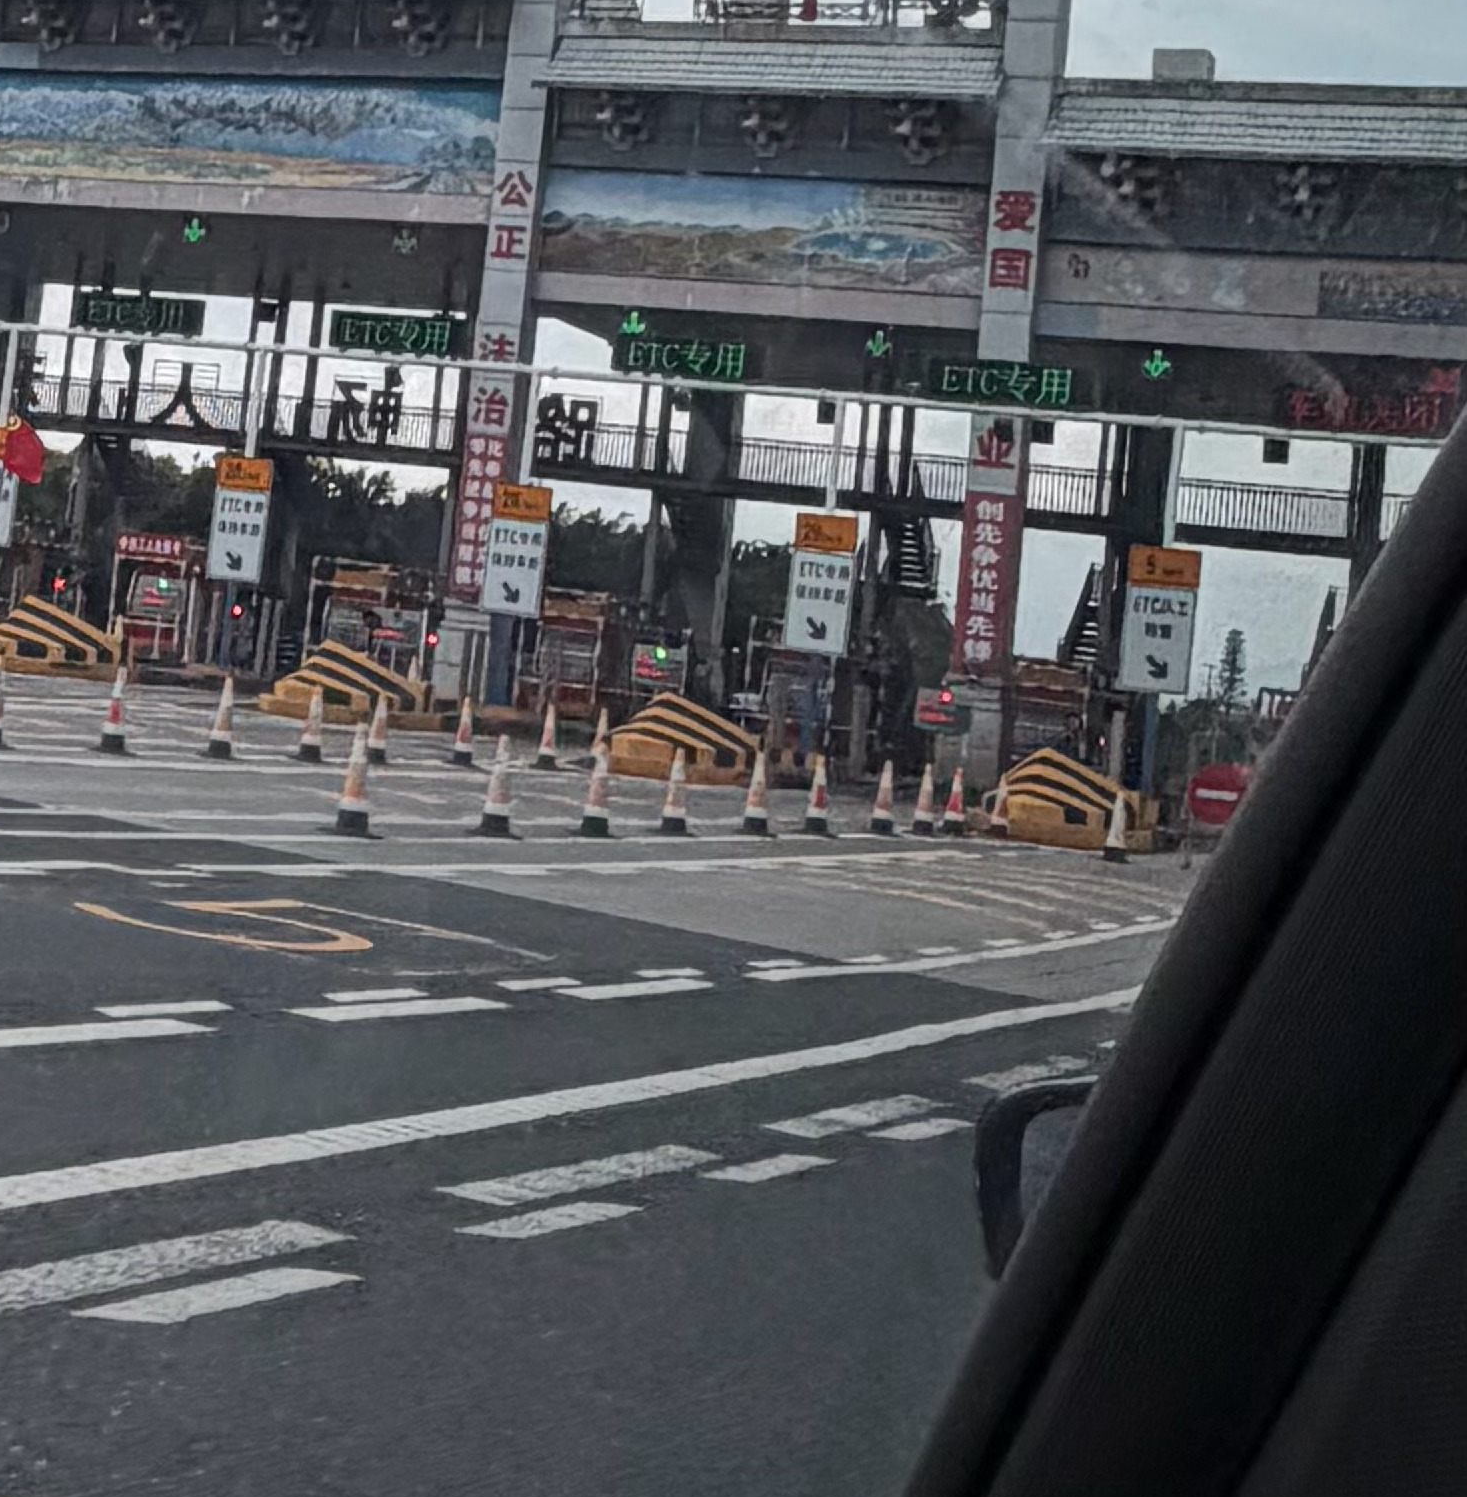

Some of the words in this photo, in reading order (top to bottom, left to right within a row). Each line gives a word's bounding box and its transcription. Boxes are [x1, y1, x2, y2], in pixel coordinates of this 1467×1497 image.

[340, 317, 450, 352] ETC专用
[627, 342, 746, 379] ETC专用
[942, 365, 1072, 405] ETC专用
